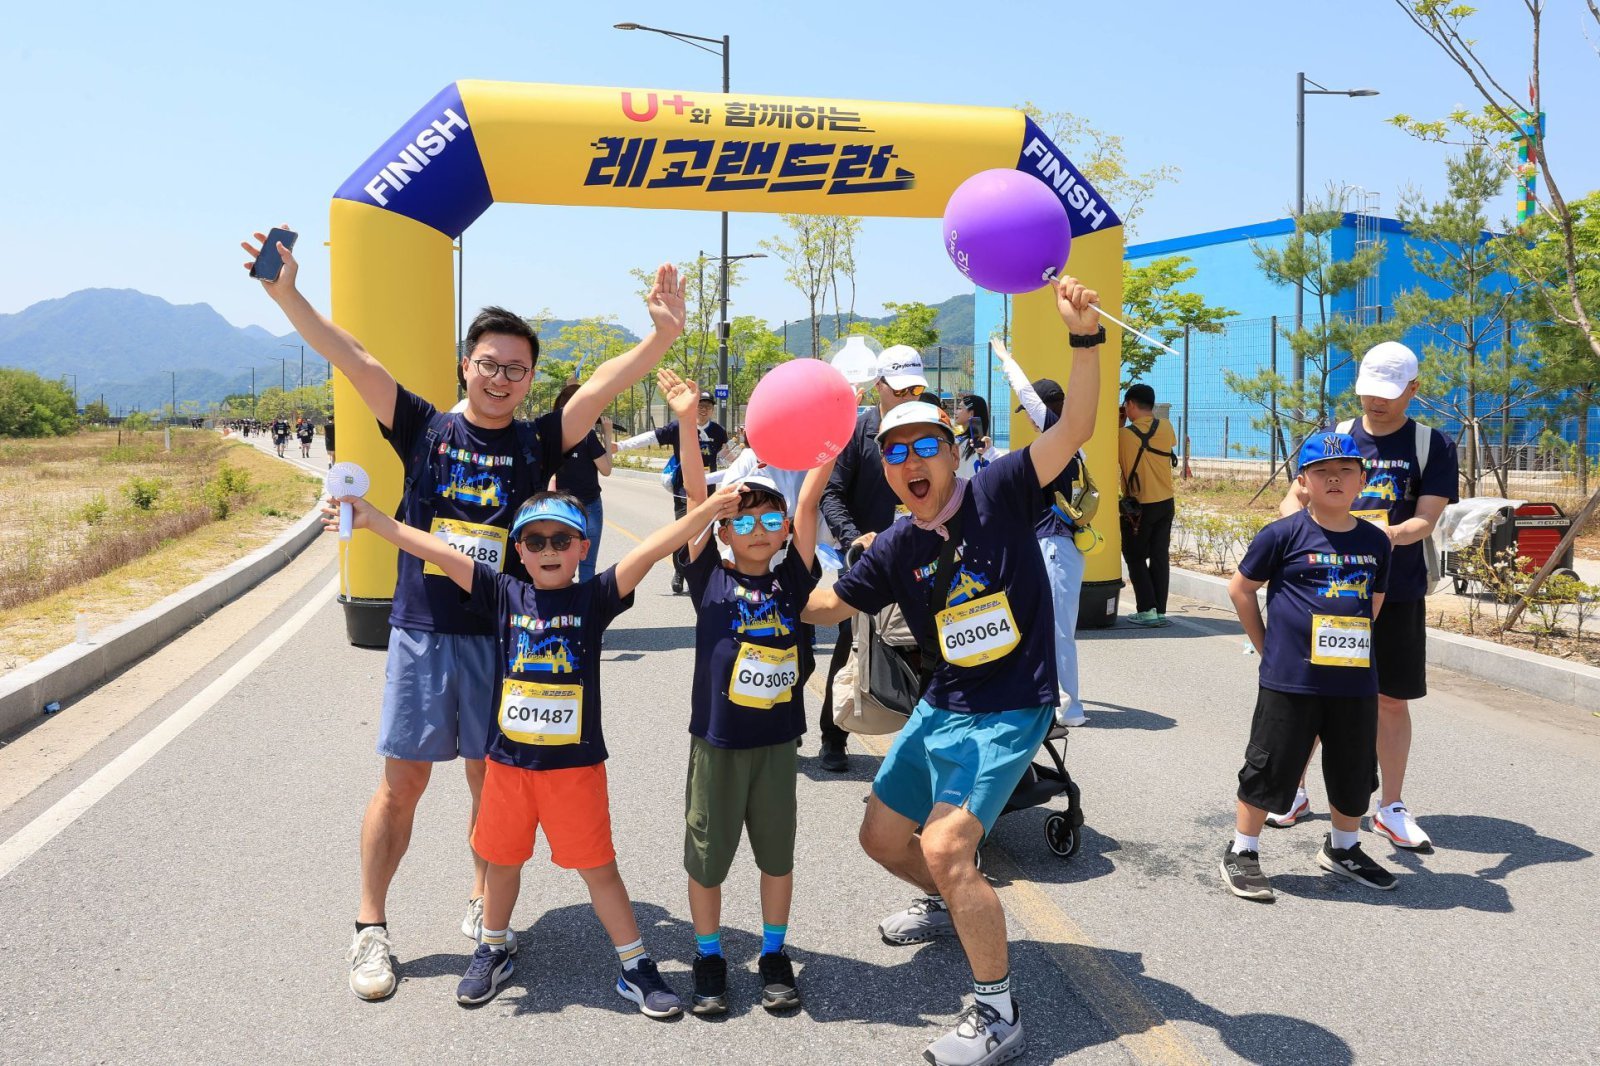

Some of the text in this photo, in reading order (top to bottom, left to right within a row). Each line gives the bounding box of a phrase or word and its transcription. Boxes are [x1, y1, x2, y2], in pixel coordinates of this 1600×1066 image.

[724, 101, 876, 133] 함께하는
[364, 108, 469, 207] FINISH
[583, 136, 916, 195] 레고랜드런
[1022, 136, 1107, 230] FINISH
[945, 618, 1011, 650] G03064
[738, 669, 796, 688] G03063
[507, 705, 574, 724] C01487
